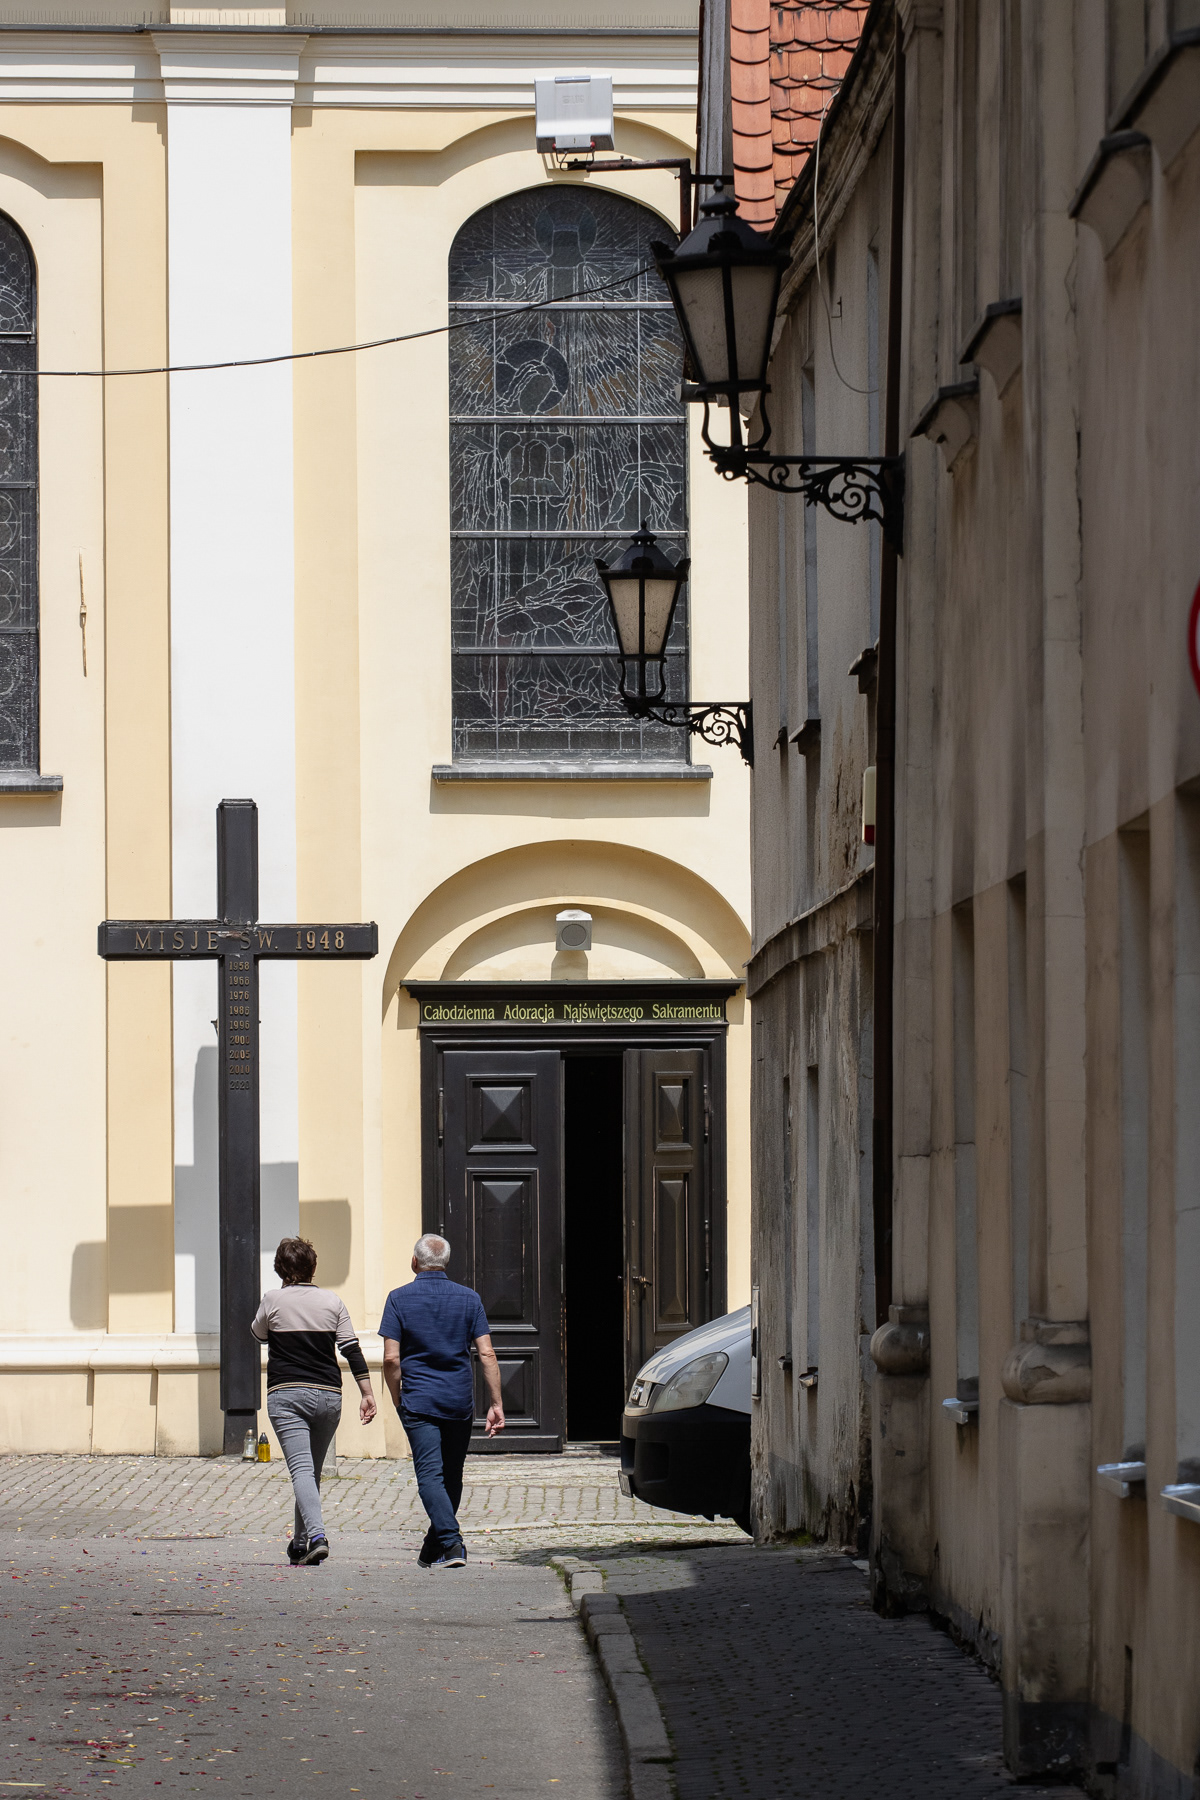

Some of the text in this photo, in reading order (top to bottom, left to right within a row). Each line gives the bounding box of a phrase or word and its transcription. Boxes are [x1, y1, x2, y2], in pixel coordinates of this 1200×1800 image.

[134, 930, 219, 950] MISJE
[295, 930, 345, 950] 1948
[229, 961, 250, 971] 1958
[229, 991, 250, 1001] 1976
[423, 1002, 721, 1023] Całodzienna Adoracja Najświętszego Sakramentu
[229, 1020, 250, 1030] 1996
[229, 1035, 250, 1045] 2000
[229, 1050, 251, 1060] 2005
[229, 1064, 250, 1074] 2010
